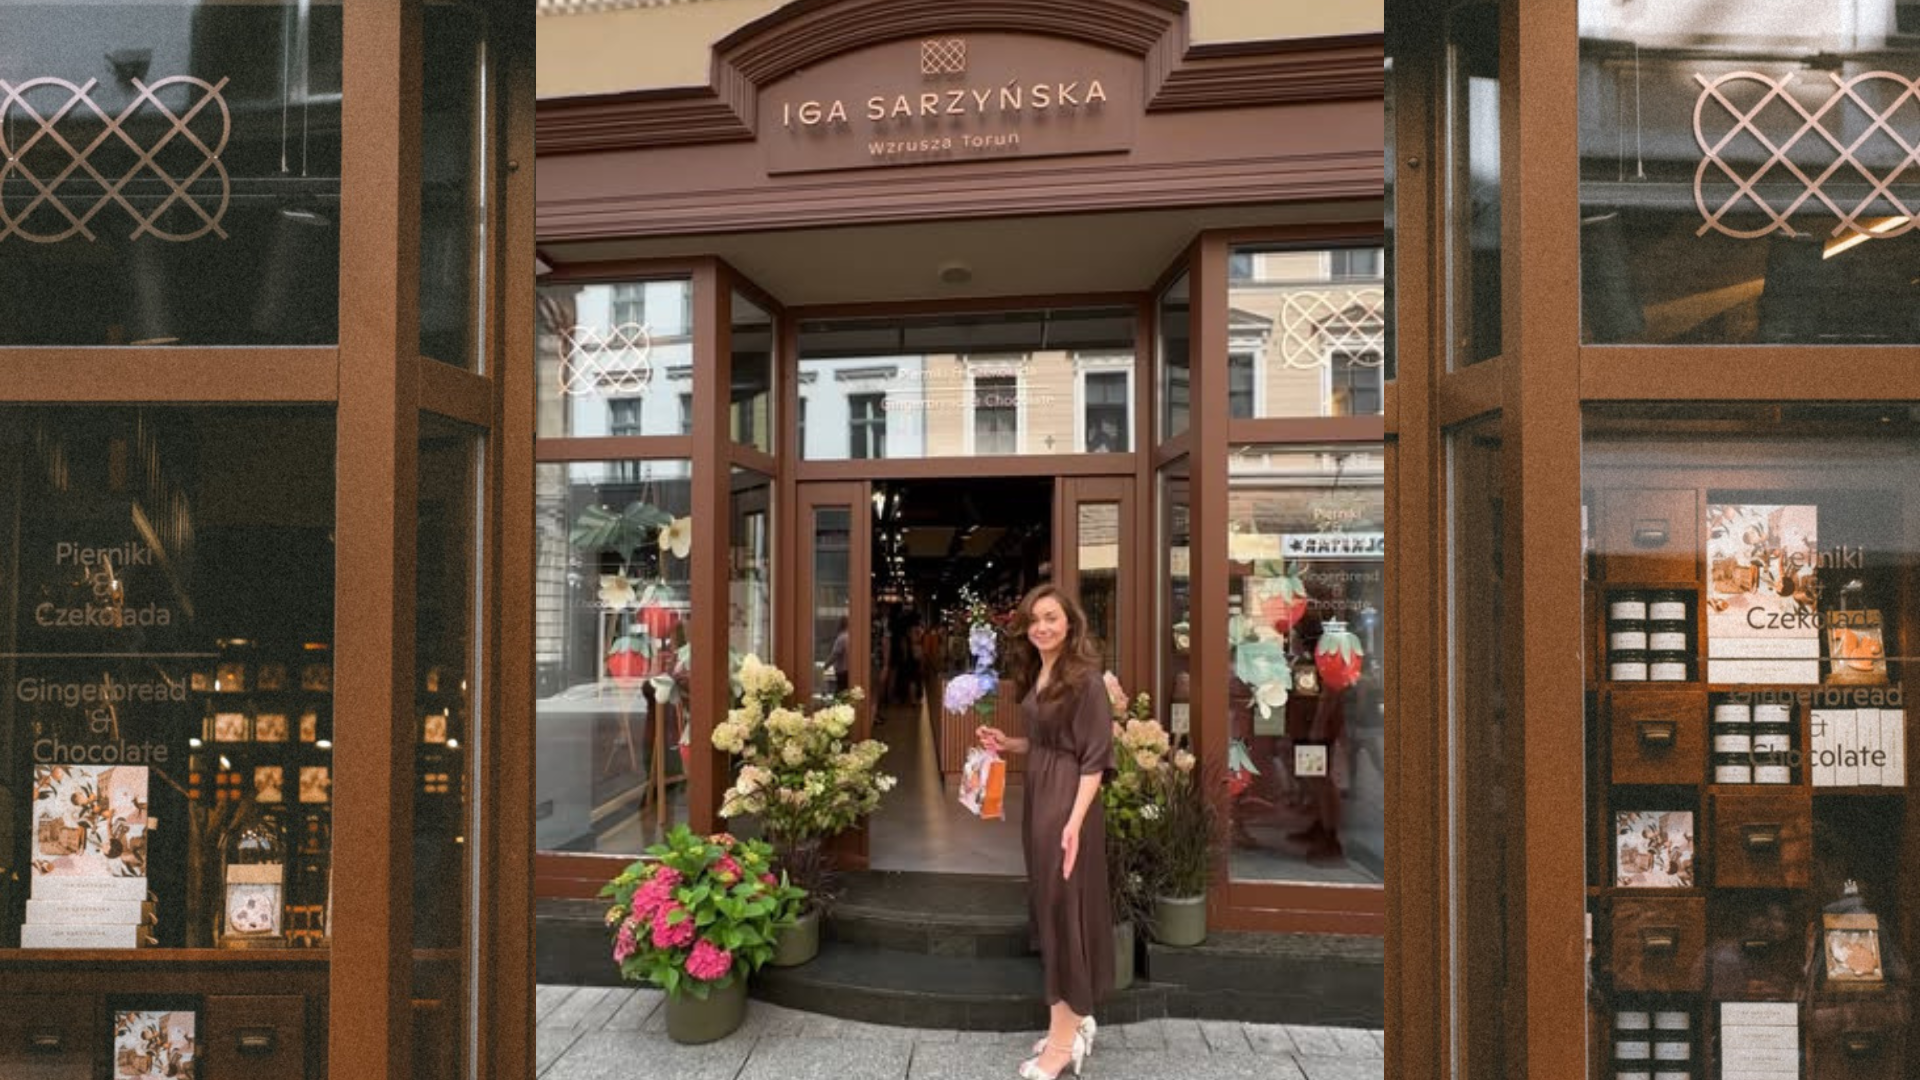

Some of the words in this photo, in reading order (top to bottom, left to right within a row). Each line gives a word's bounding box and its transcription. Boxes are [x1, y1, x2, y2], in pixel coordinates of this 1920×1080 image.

[782, 100, 848, 127] IGA
[867, 80, 1107, 120] SARZYŃSKA
[868, 138, 951, 155] Wzrusza
[55, 543, 151, 566] Pierniki
[35, 602, 171, 627] Czekolada
[1746, 605, 1882, 630] Czekolada
[16, 677, 187, 707] Gingerbread
[1730, 682, 1903, 711] Gingerbread
[90, 709, 112, 734] &
[33, 738, 169, 763] Chocolate
[1750, 743, 1887, 768] Chocolate
